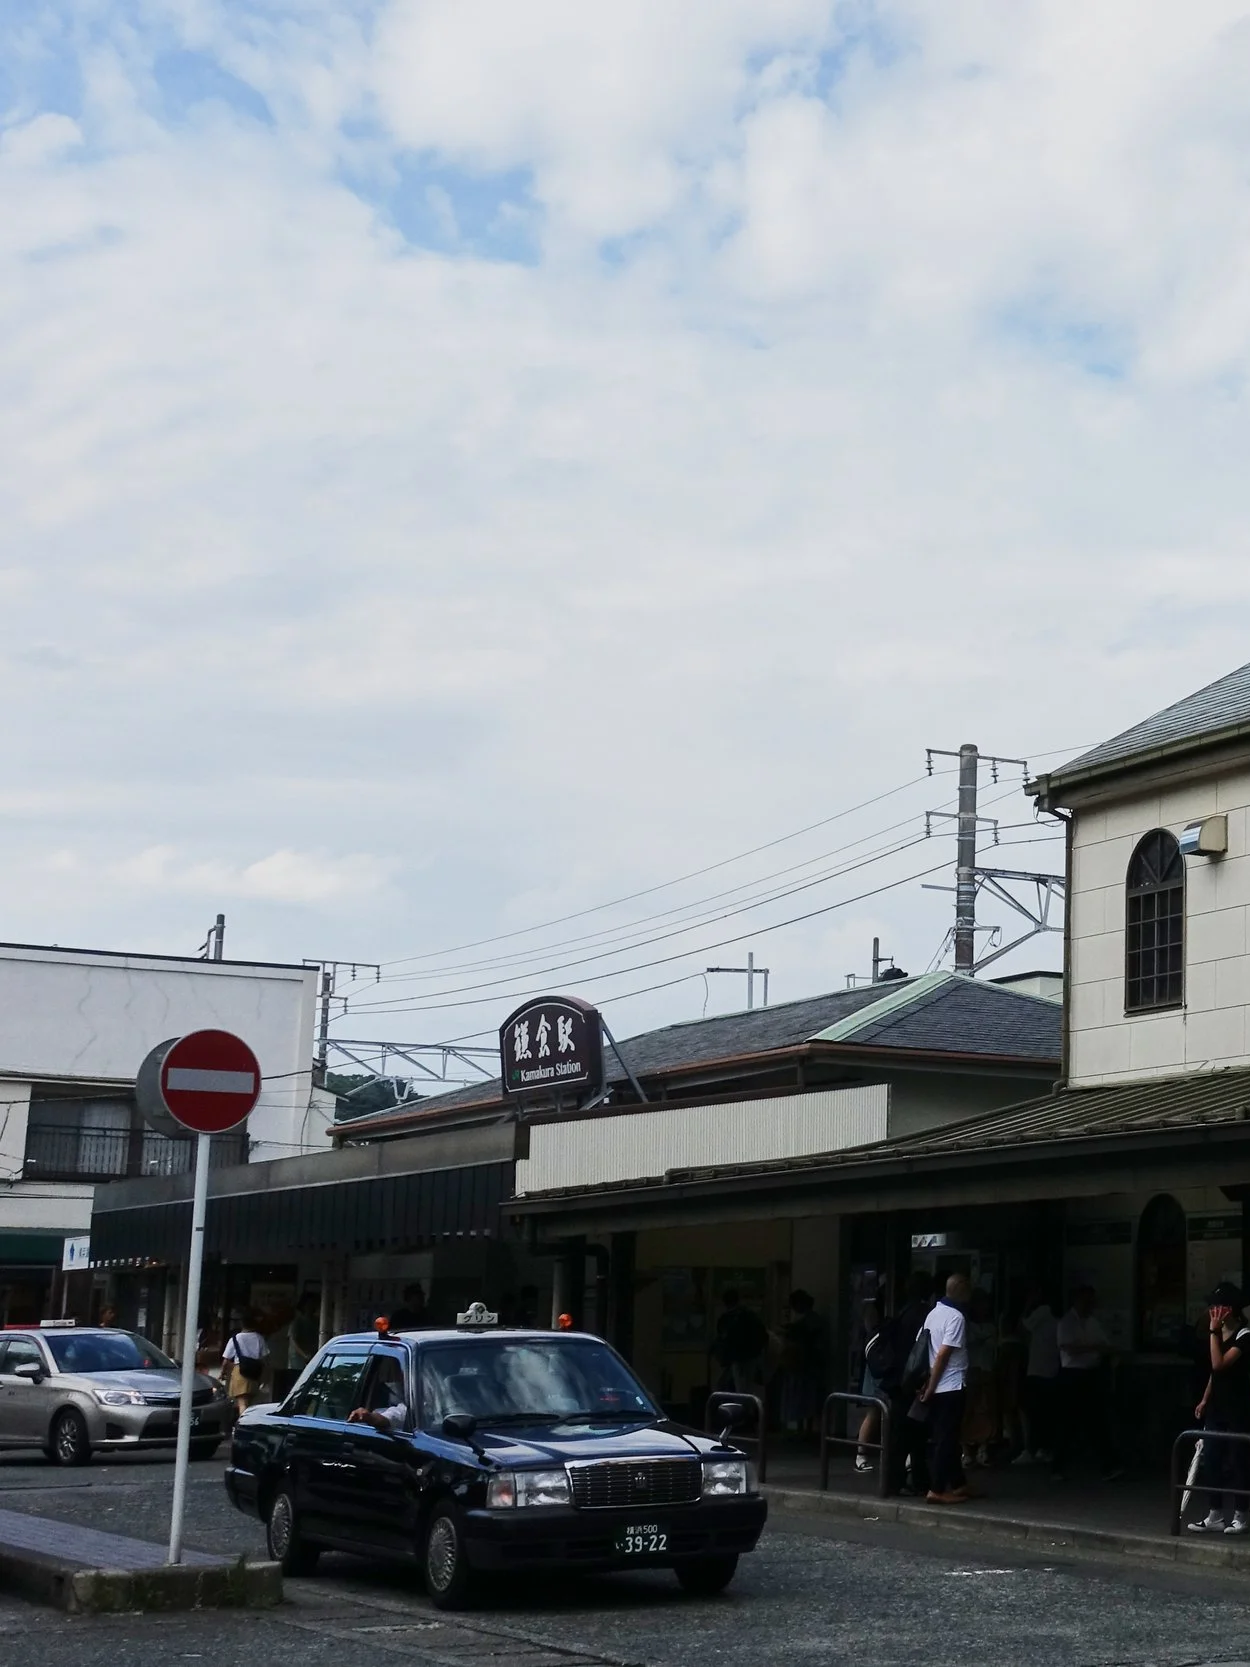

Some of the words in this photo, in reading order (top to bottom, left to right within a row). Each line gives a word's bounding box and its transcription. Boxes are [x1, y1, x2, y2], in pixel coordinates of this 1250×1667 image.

[520, 1064, 555, 1082] Kamakura
[555, 1059, 581, 1076] Station
[624, 1533, 668, 1553] 39-22
